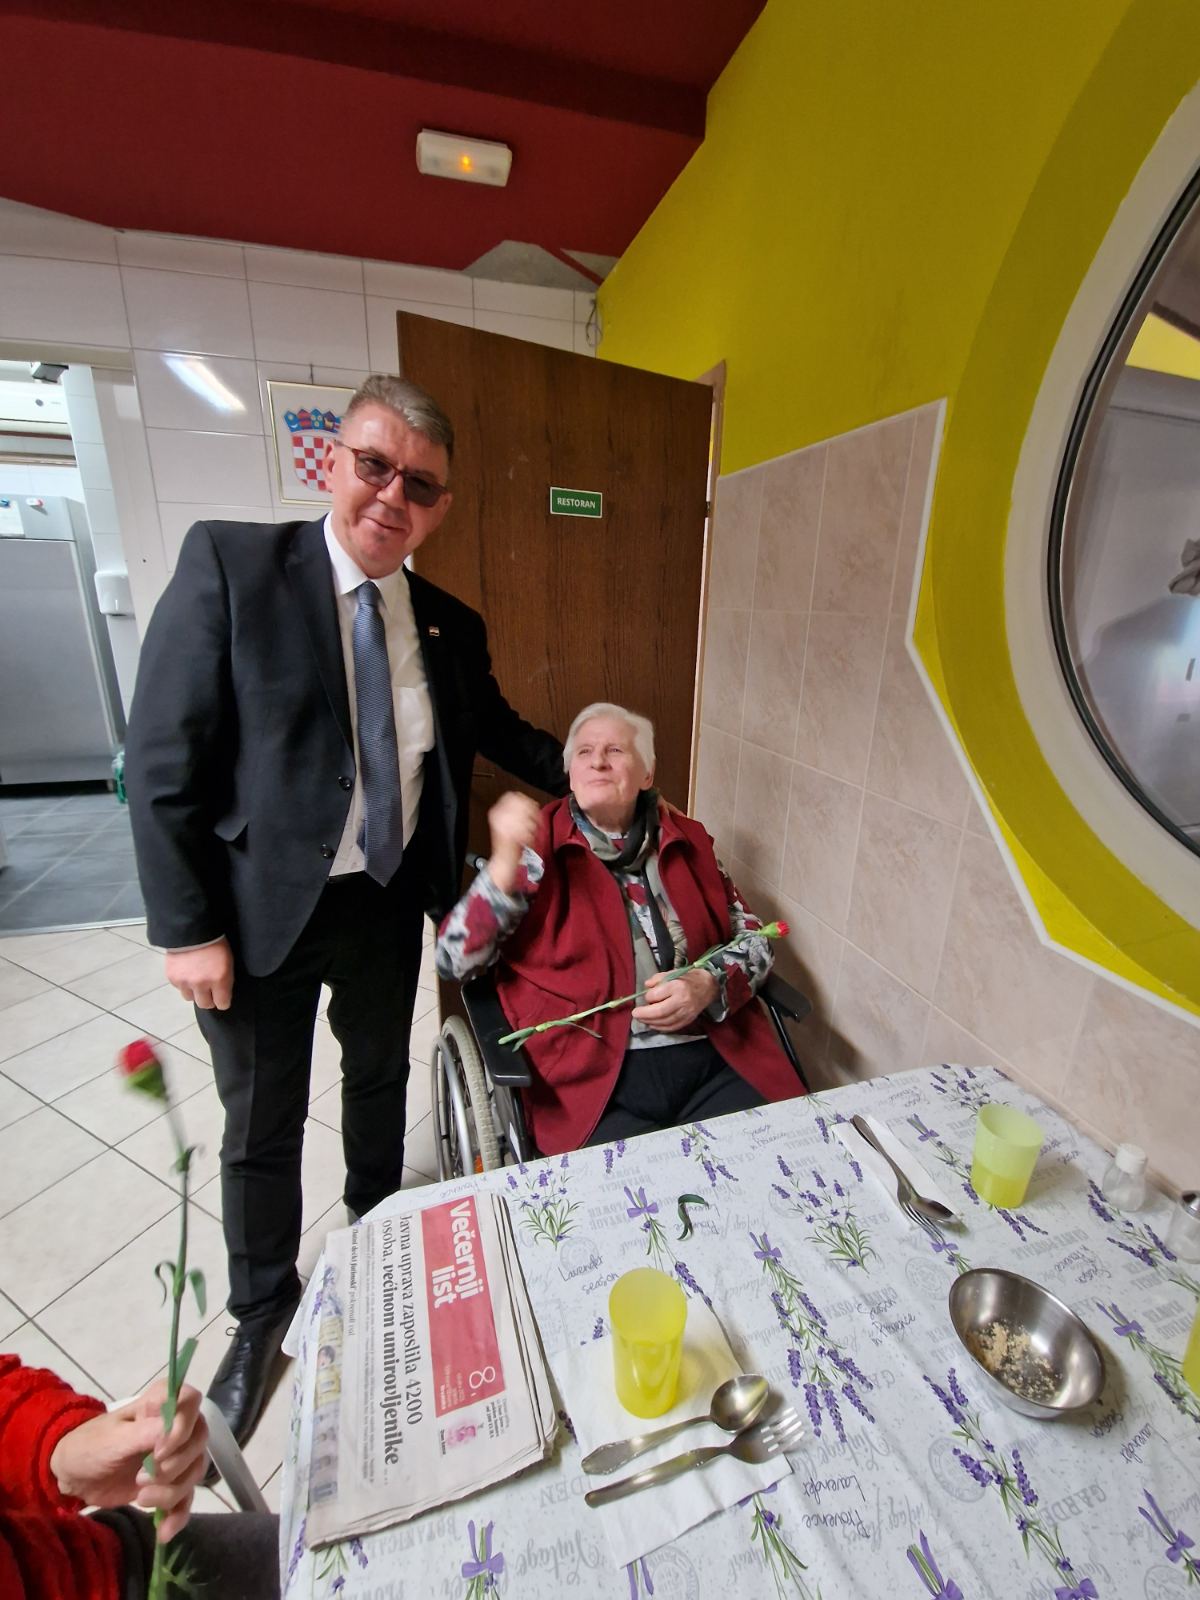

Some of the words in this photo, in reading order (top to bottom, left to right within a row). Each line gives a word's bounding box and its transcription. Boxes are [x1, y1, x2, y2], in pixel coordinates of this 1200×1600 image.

[557, 497, 595, 509] RESTORAN
[382, 1219, 396, 1262] osoba,
[400, 1215, 414, 1250] Javna
[450, 1200, 484, 1299] Večernji
[398, 1253, 415, 1300] uprava
[432, 1265, 457, 1308] list
[558, 1254, 603, 1282] Lavender
[382, 1264, 398, 1327] većinom
[400, 1302, 421, 1375] zaposlila
[380, 1331, 403, 1465] umirovljenike
[406, 1379, 423, 1425] 4200
[802, 1474, 866, 1506] Lavender
[1035, 1482, 1107, 1523] GARDE
[801, 1508, 871, 1540] Provence
[513, 1529, 600, 1586] Vintage
